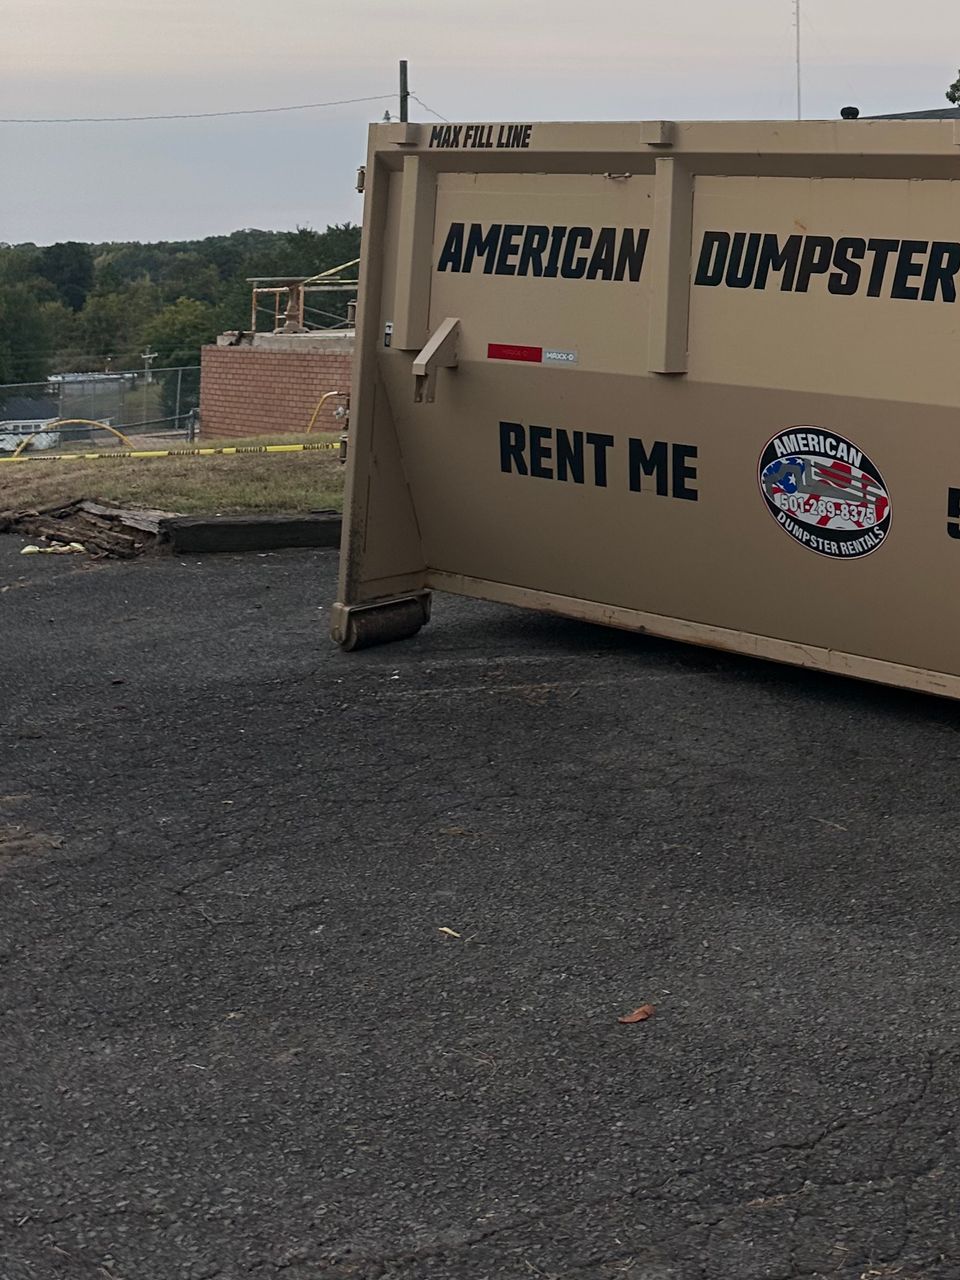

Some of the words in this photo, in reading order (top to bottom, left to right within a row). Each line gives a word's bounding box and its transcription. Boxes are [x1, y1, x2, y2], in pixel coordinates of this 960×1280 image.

[429, 125, 463, 148] MAX
[462, 125, 493, 148] FILL
[496, 125, 532, 148] LINE
[437, 222, 650, 282] AMERICAN
[499, 421, 614, 487] RENT
[629, 437, 698, 501] ME
[773, 433, 862, 468] AMERICAN
[780, 494, 875, 525] 501-289-8375
[777, 512, 839, 554] DUMPSTER
[839, 526, 885, 555] RENTALS
